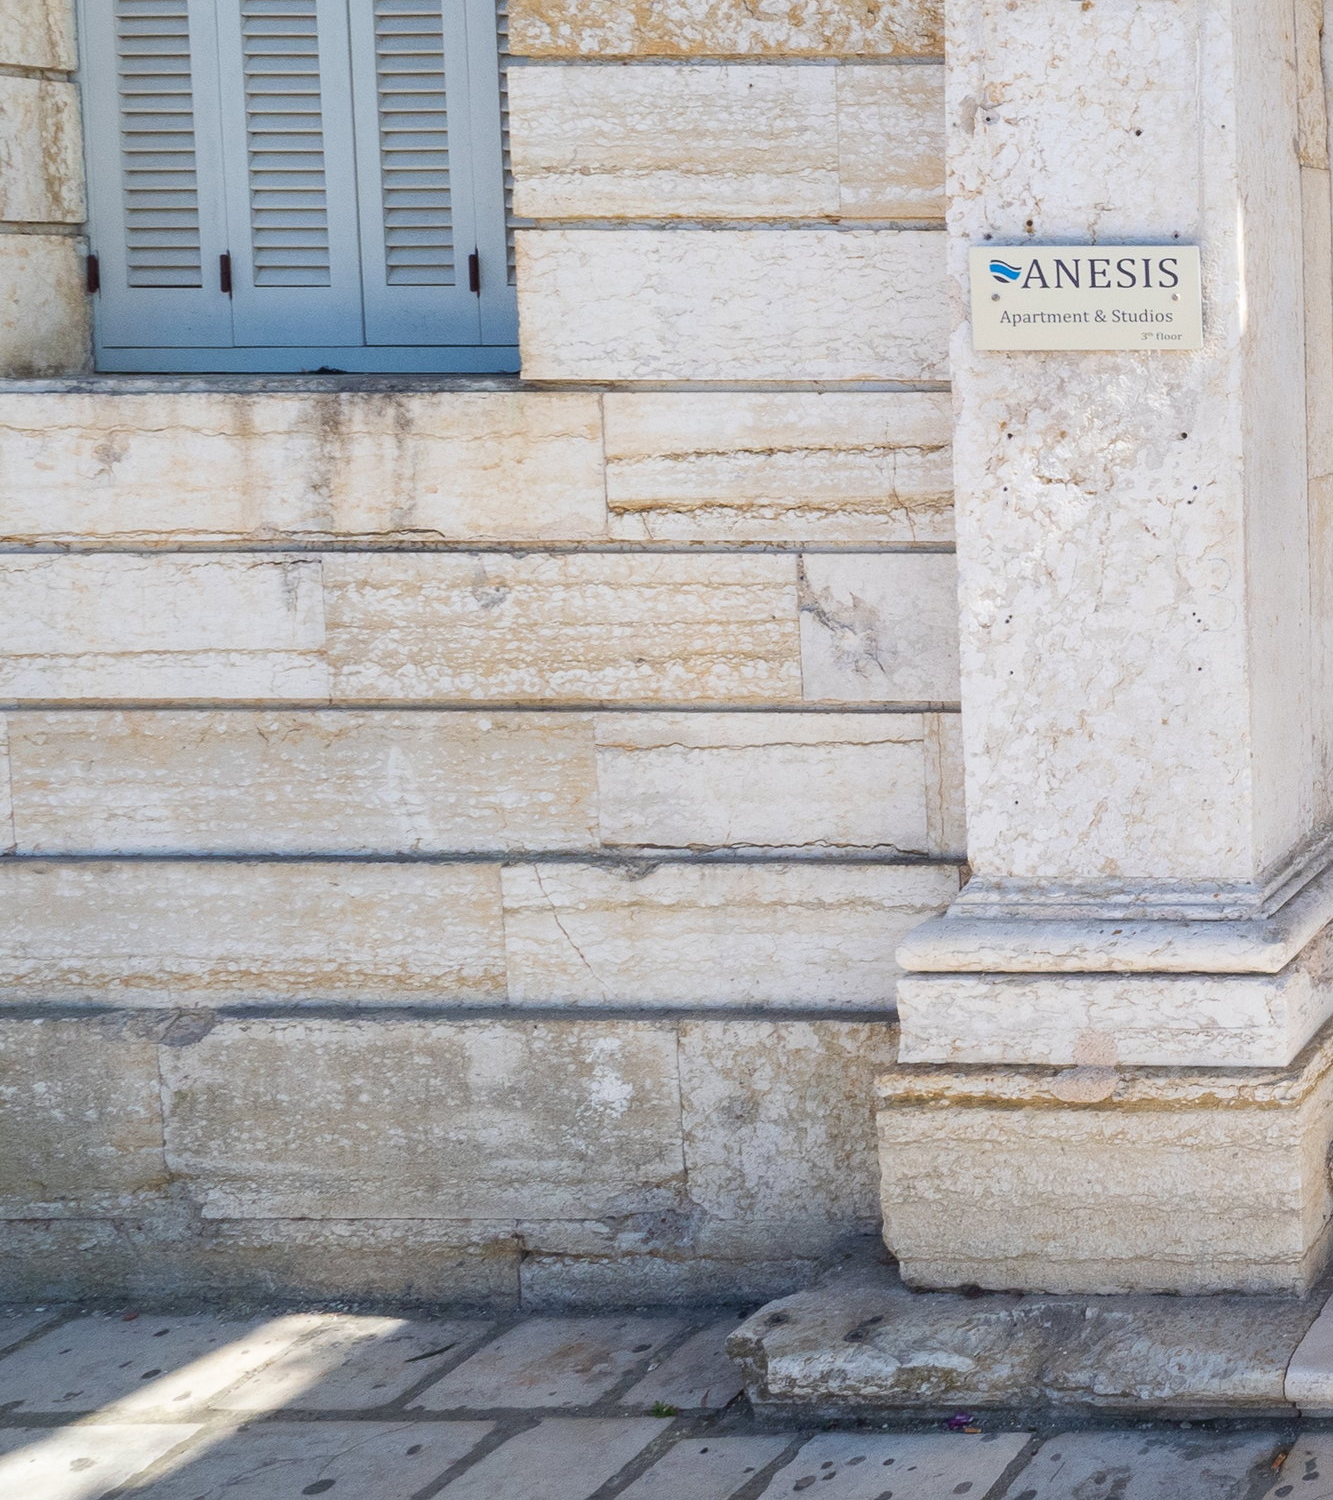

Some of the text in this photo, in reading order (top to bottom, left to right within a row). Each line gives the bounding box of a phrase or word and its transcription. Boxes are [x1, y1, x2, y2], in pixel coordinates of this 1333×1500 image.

[1021, 258, 1179, 289] ANESIS
[1000, 309, 1174, 328] Apartment & Studios
